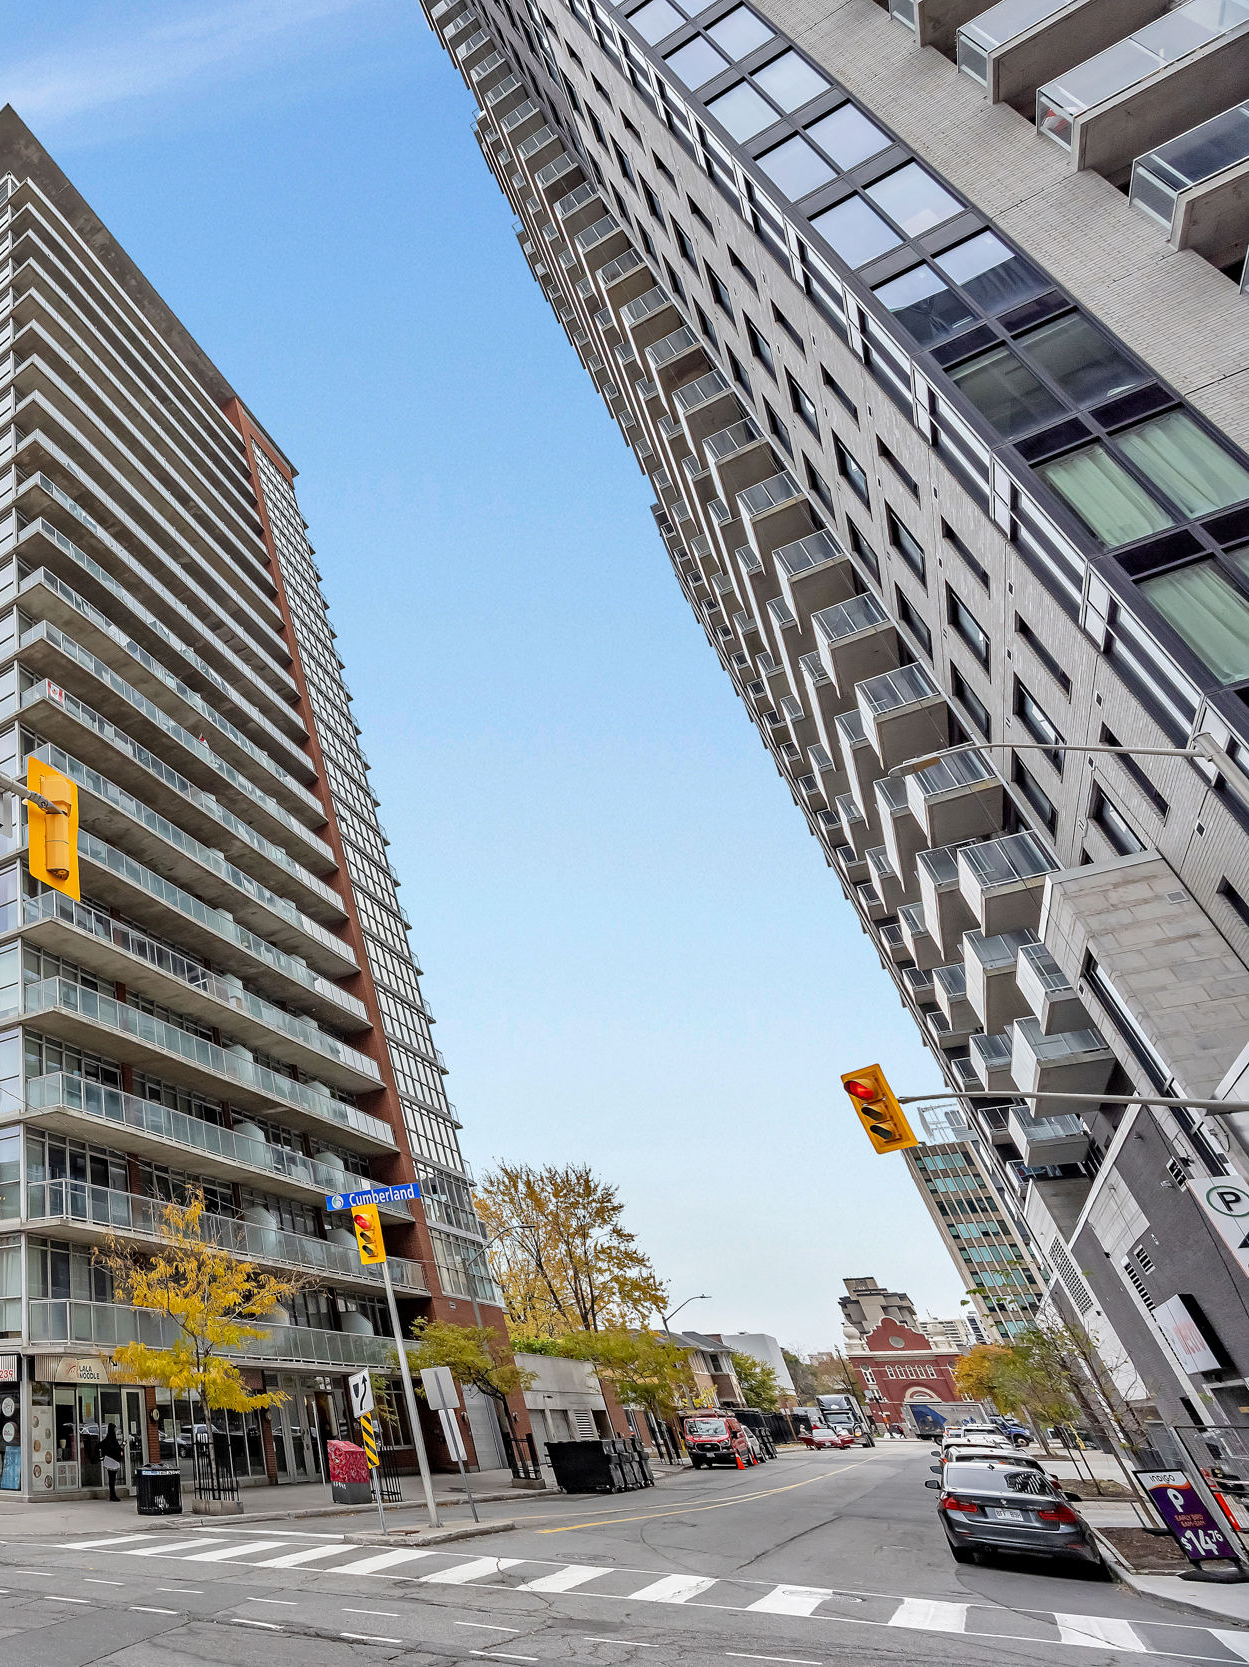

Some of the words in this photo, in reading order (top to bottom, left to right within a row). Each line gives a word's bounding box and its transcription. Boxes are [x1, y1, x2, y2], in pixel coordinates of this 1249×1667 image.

[349, 1184, 415, 1207] Cumberland
[1216, 1191, 1242, 1212] P
[79, 1365, 93, 1373] LALA
